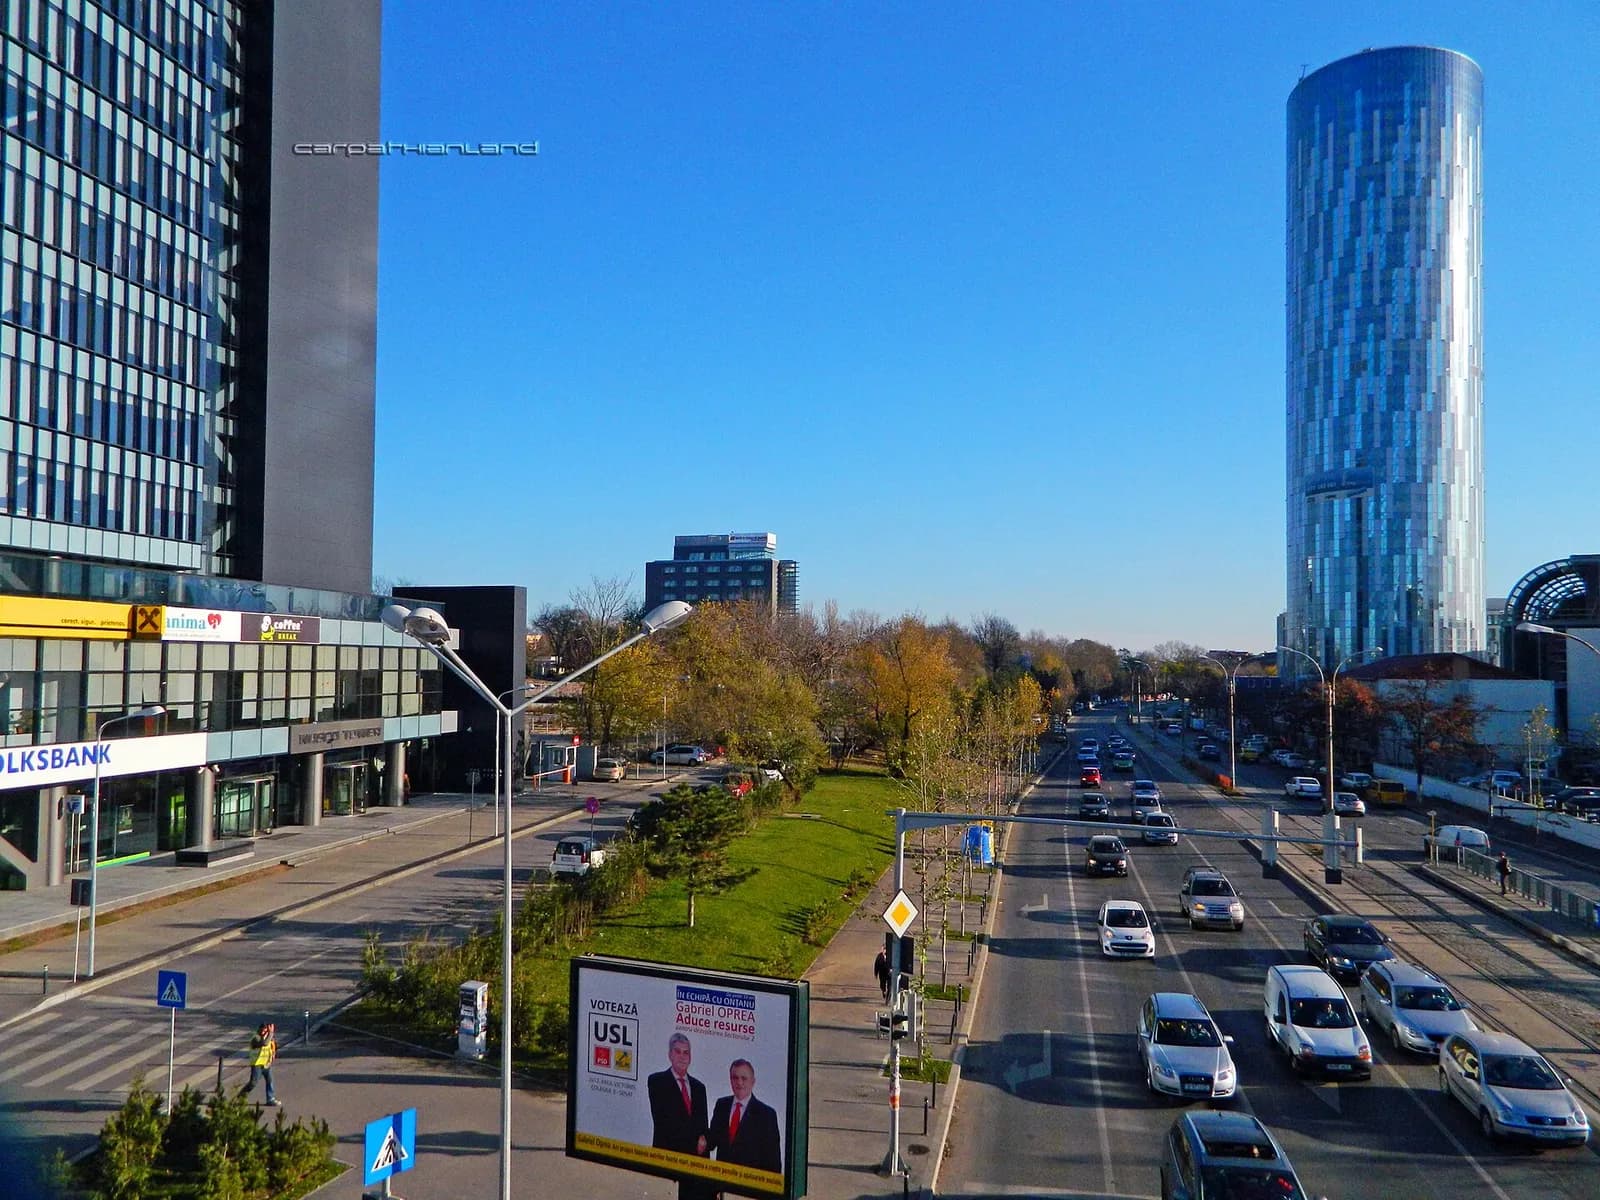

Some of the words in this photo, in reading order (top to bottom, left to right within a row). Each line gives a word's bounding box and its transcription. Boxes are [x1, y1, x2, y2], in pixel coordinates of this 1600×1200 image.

[274, 619, 301, 631] coffee
[0, 744, 111, 774] LKSBANK
[590, 999, 638, 1016] VOTEAZĂ
[711, 996, 723, 1005] CU
[676, 1001, 714, 1017] Gabriel
[717, 1007, 756, 1023] OPREA
[594, 1021, 633, 1046] USL
[676, 1013, 711, 1028] Aduce
[713, 1020, 755, 1035] resurse
